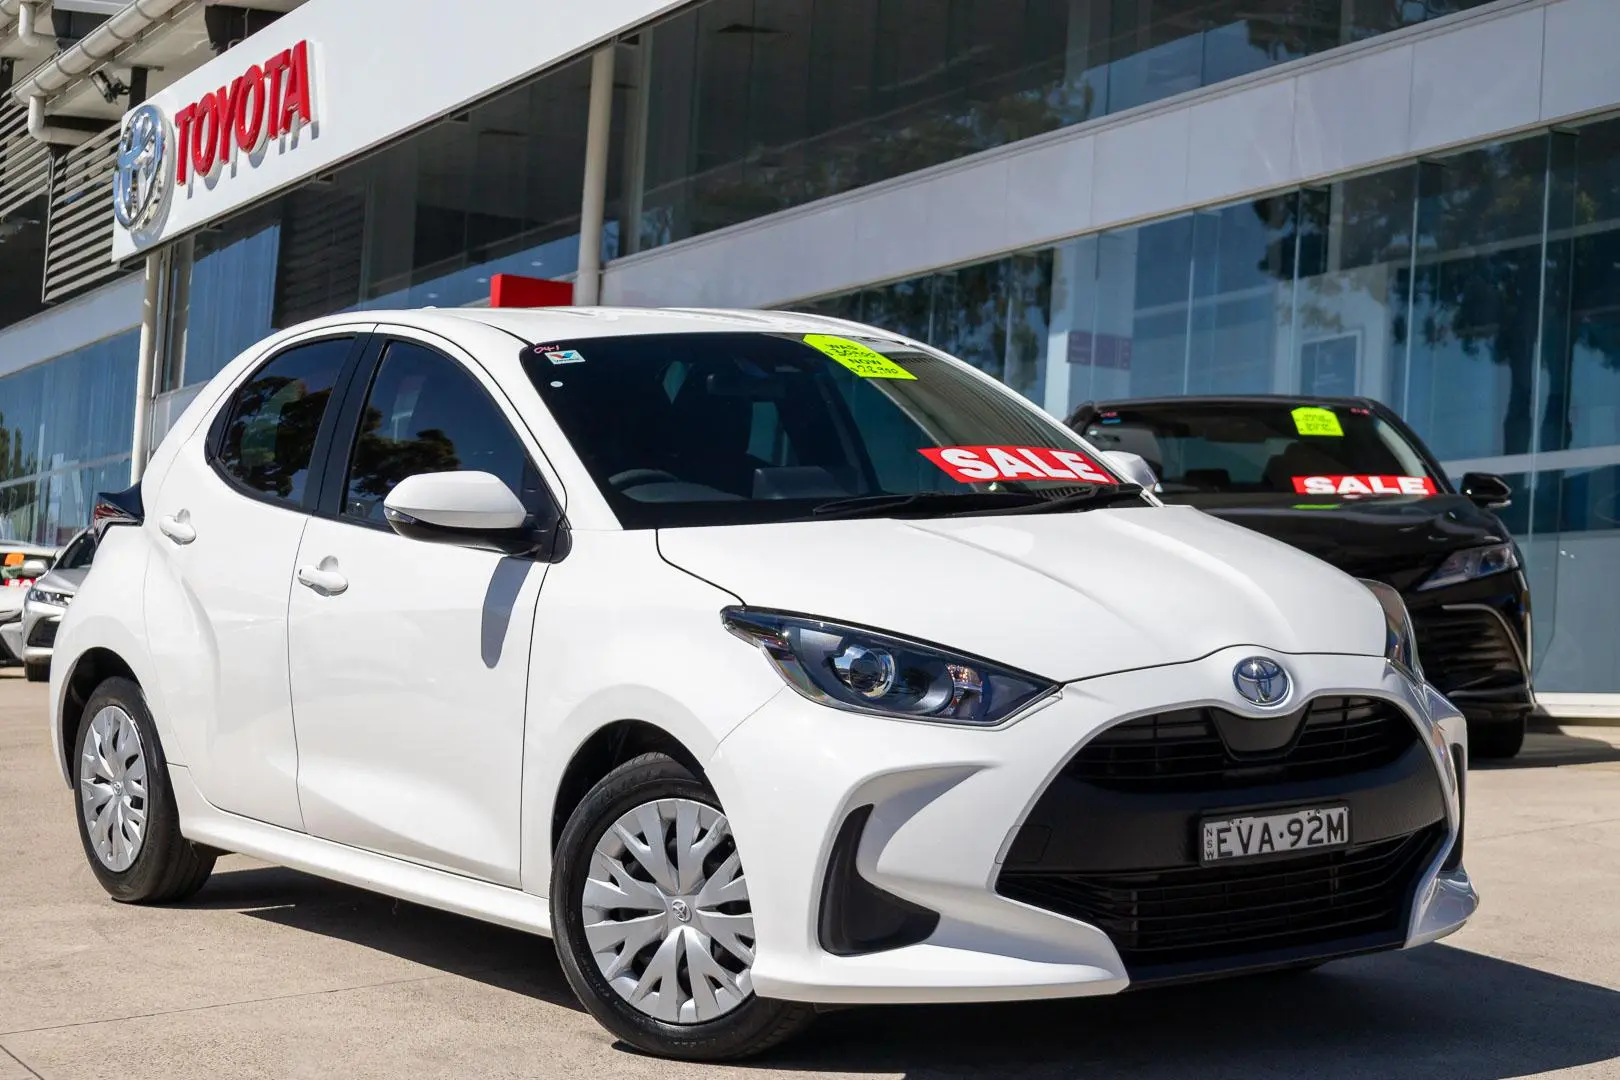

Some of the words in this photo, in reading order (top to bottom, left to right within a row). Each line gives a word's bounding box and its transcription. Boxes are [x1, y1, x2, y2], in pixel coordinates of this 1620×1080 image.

[175, 40, 311, 186] TOYOTA
[940, 448, 1110, 482] SALE
[1303, 476, 1430, 495] SALE
[1205, 827, 1215, 859] NSW
